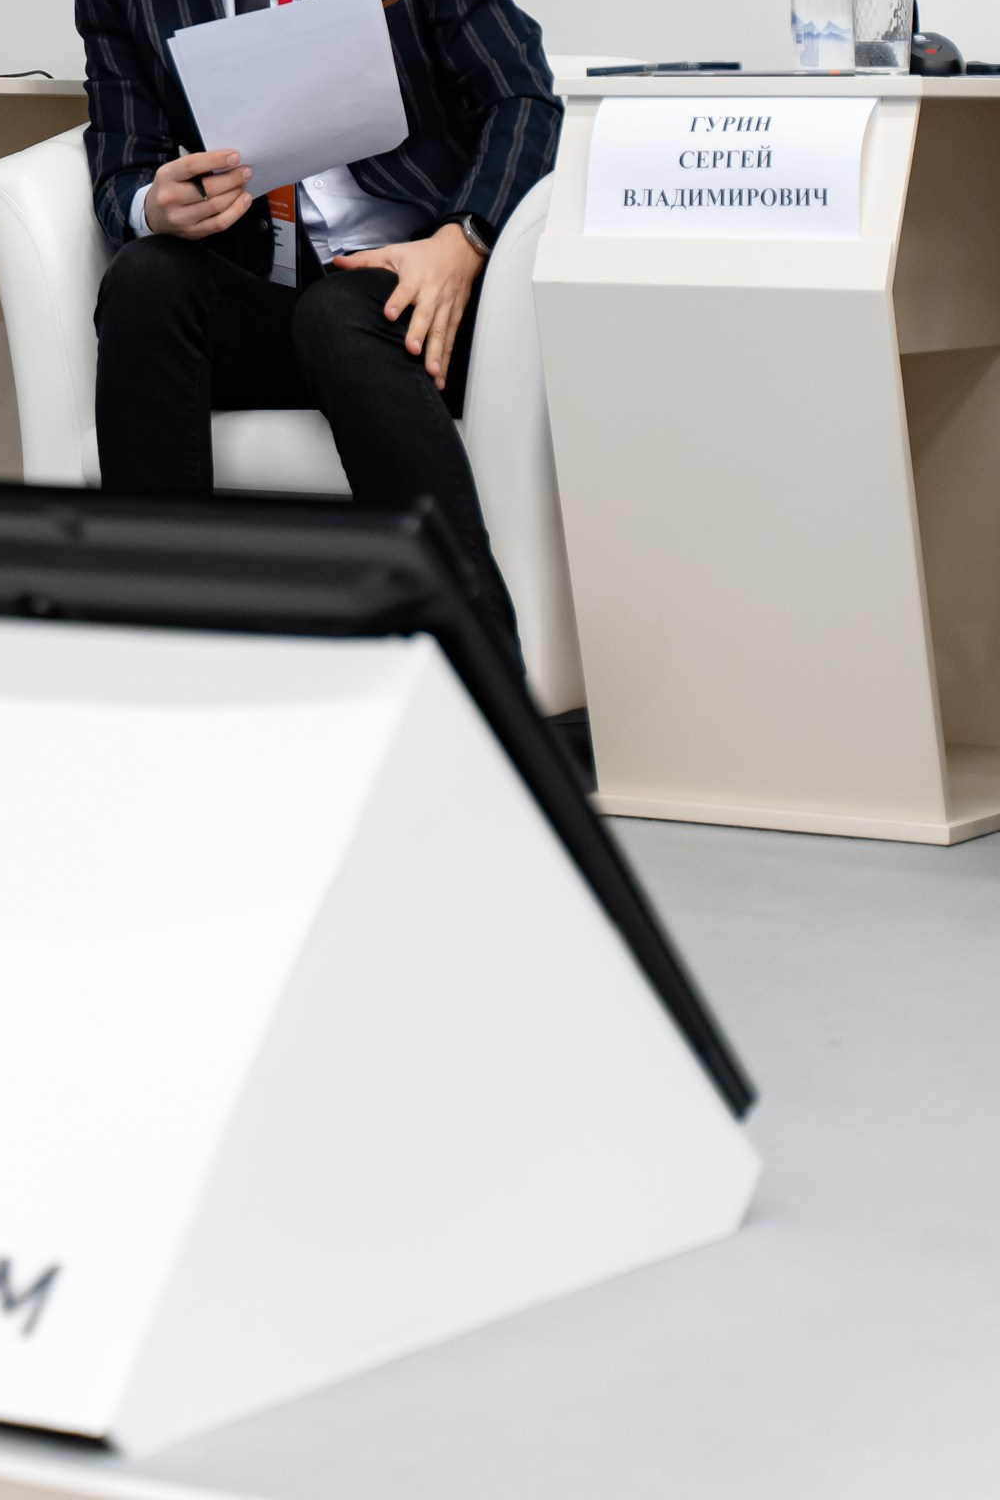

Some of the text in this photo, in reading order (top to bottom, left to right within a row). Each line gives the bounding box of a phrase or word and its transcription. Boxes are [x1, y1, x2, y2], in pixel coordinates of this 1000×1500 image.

[689, 116, 773, 133] ГУРИН
[679, 146, 773, 169] СЕРГЕЙ
[623, 188, 829, 211] ВЛАДИМИРОВИЧ
